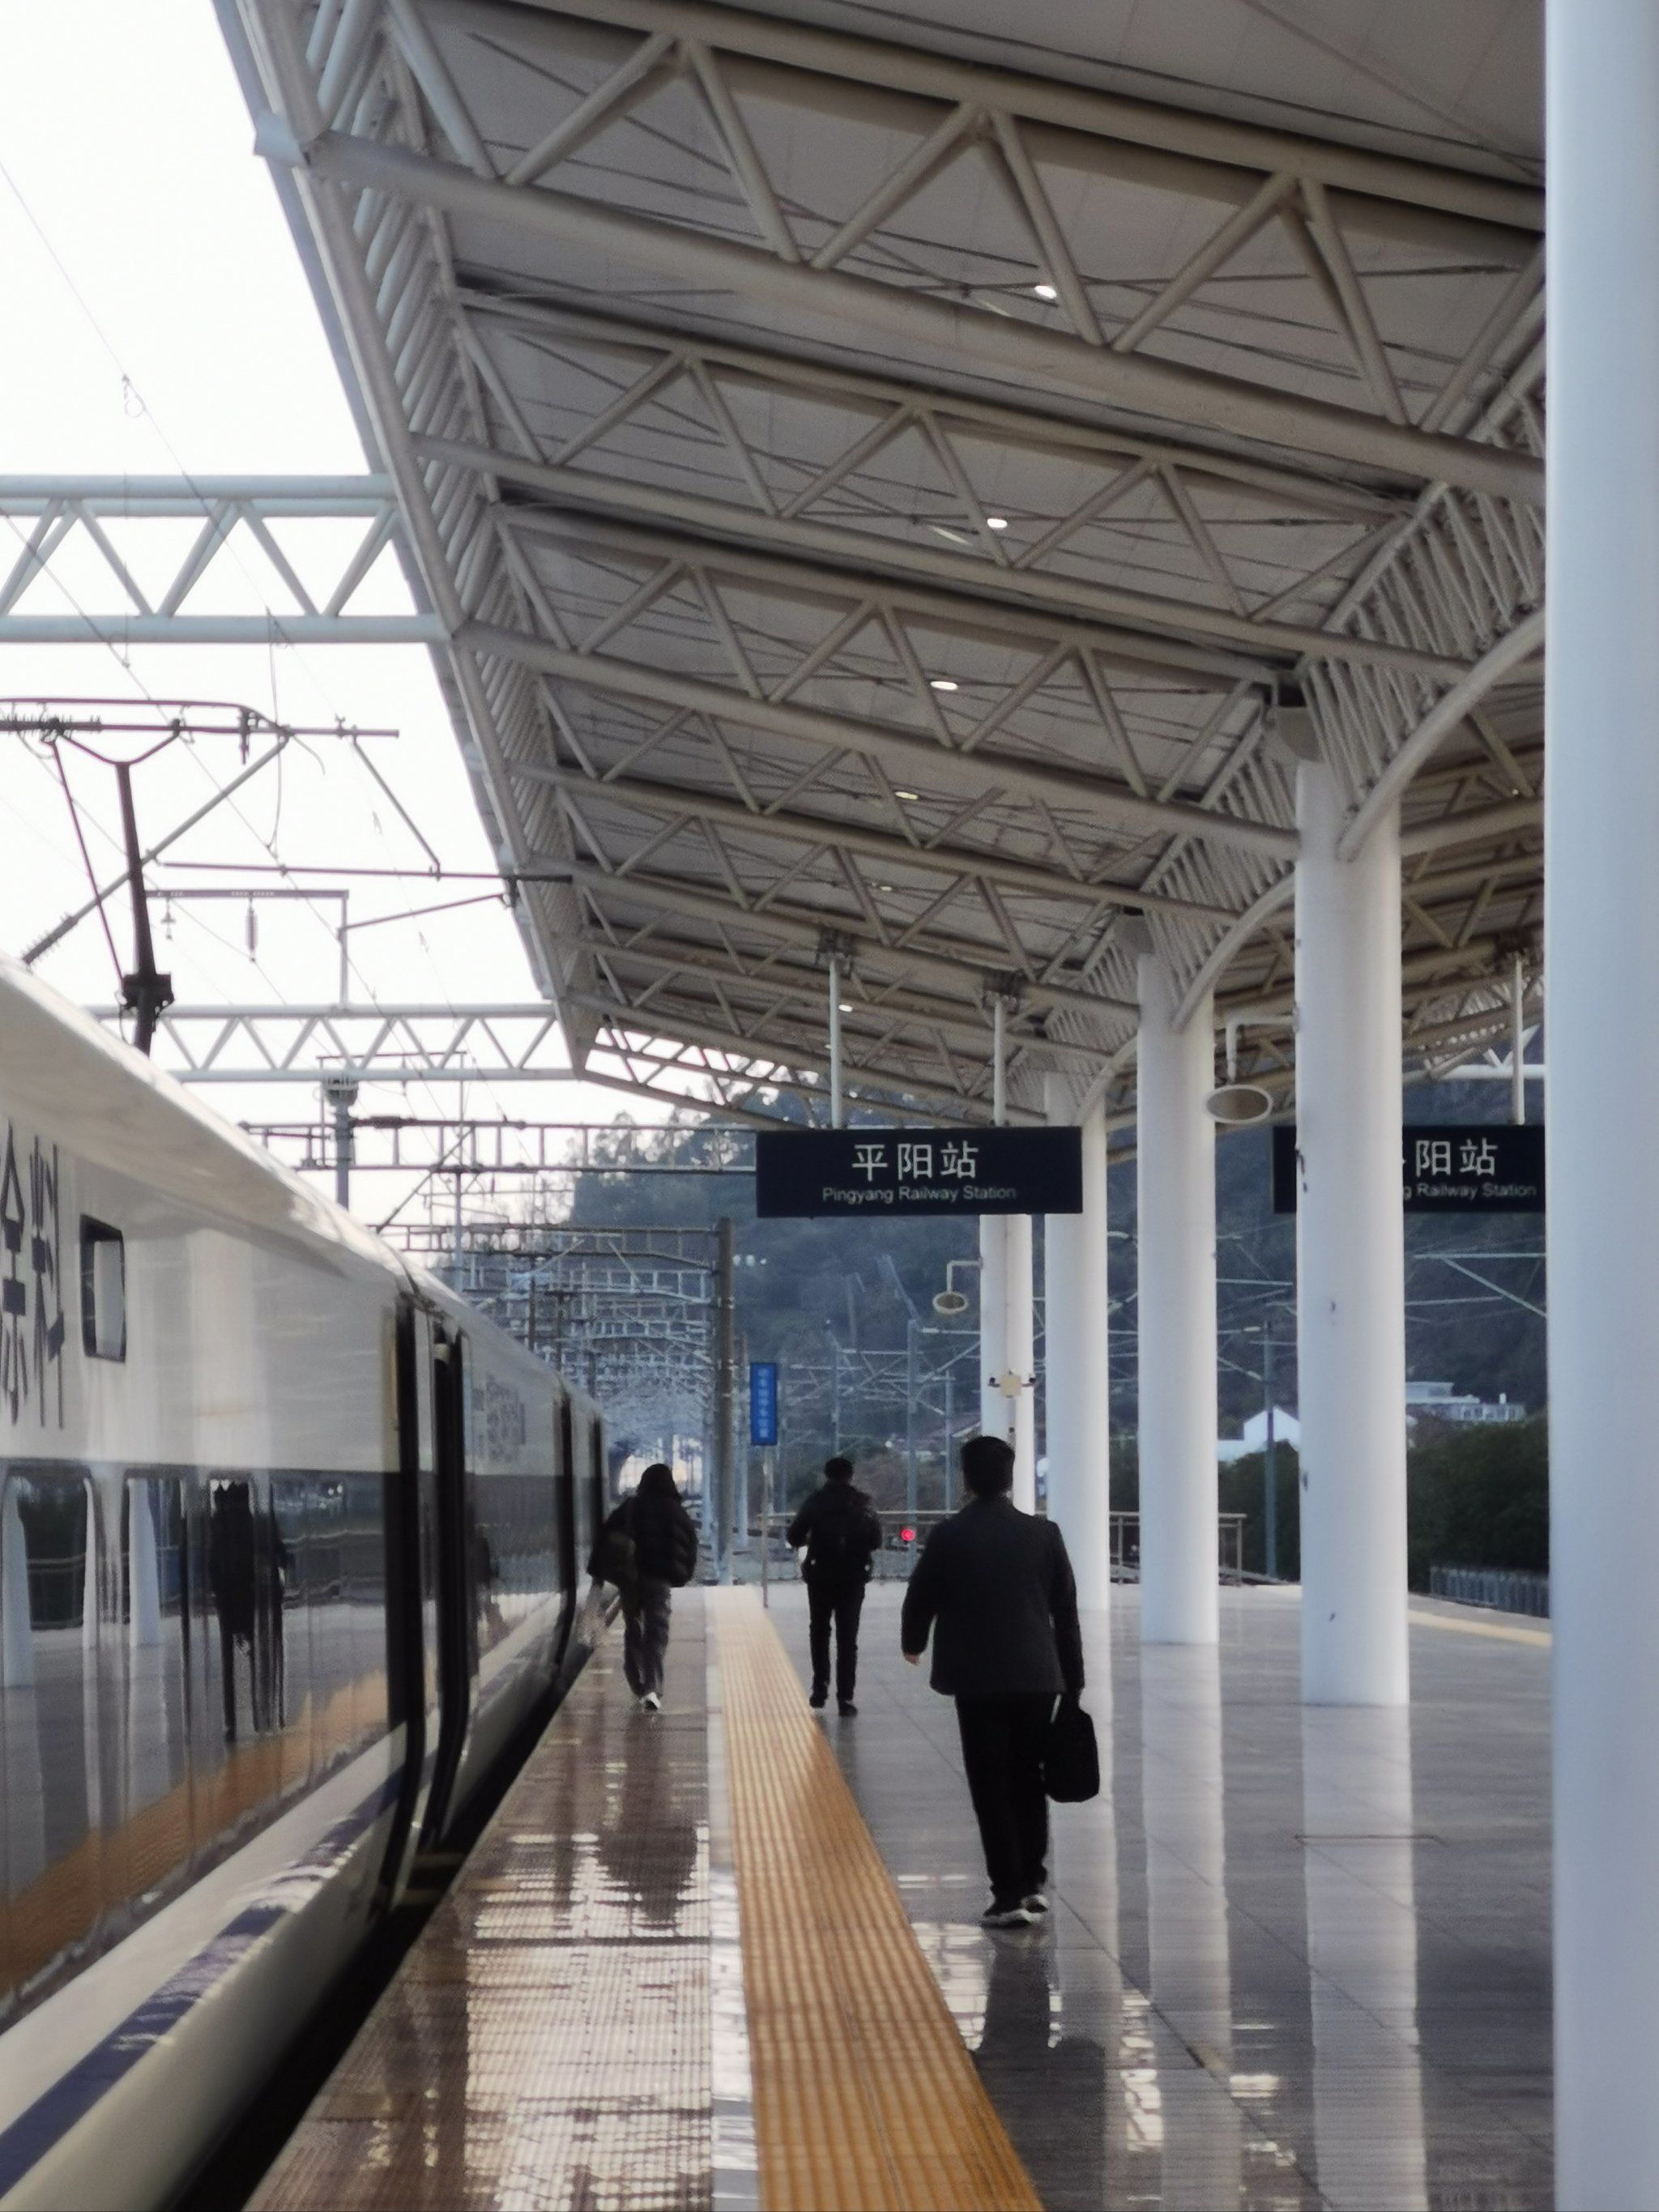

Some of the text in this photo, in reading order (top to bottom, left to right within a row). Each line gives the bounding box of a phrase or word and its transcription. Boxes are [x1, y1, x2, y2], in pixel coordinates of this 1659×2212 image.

[851, 1140, 979, 1182] 平阳站
[1403, 1138, 1498, 1178] 阳站
[822, 1185, 1017, 1204] Pingyang Railway Station
[1417, 1182, 1478, 1201] Railway
[1482, 1182, 1537, 1198] Station
